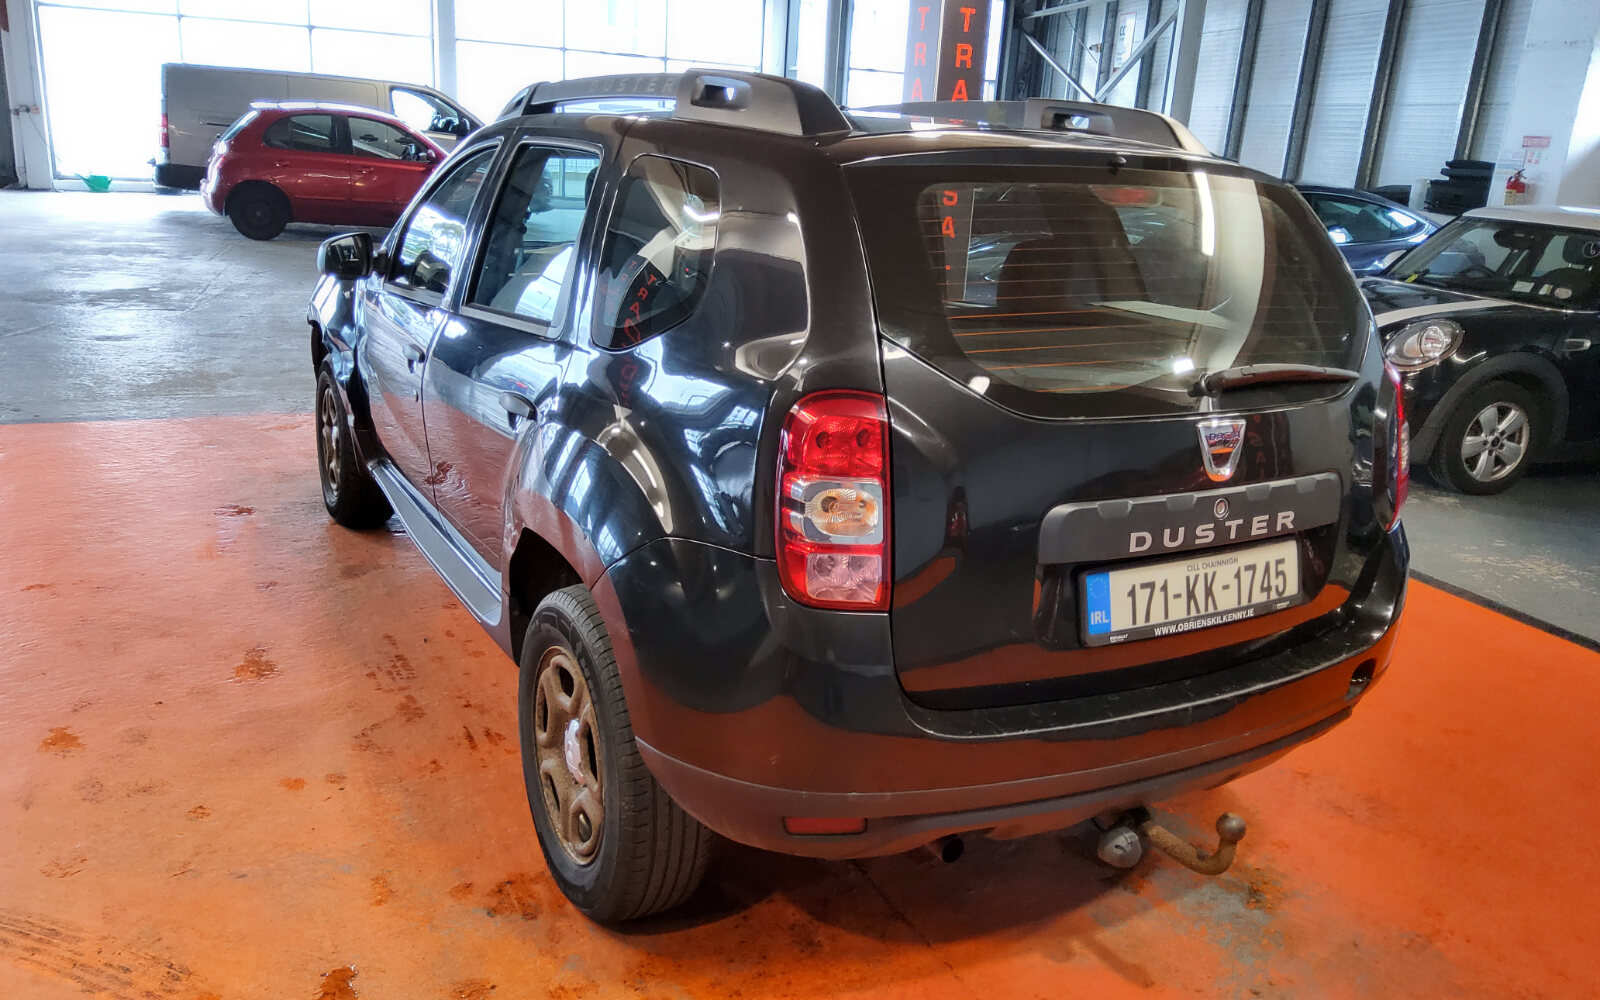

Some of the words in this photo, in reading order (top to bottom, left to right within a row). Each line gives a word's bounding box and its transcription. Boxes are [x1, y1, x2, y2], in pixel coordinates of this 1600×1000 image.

[911, 7, 930, 101] TRA
[951, 7, 977, 102] TRA
[1129, 510, 1295, 552] DUSTER
[1186, 564, 1200, 572] CILL
[1127, 558, 1287, 626] 171-KK-1745
[1090, 610, 1109, 625] IRL
[1154, 608, 1255, 636] WWW.OBRIENSKILKENNY.IE
